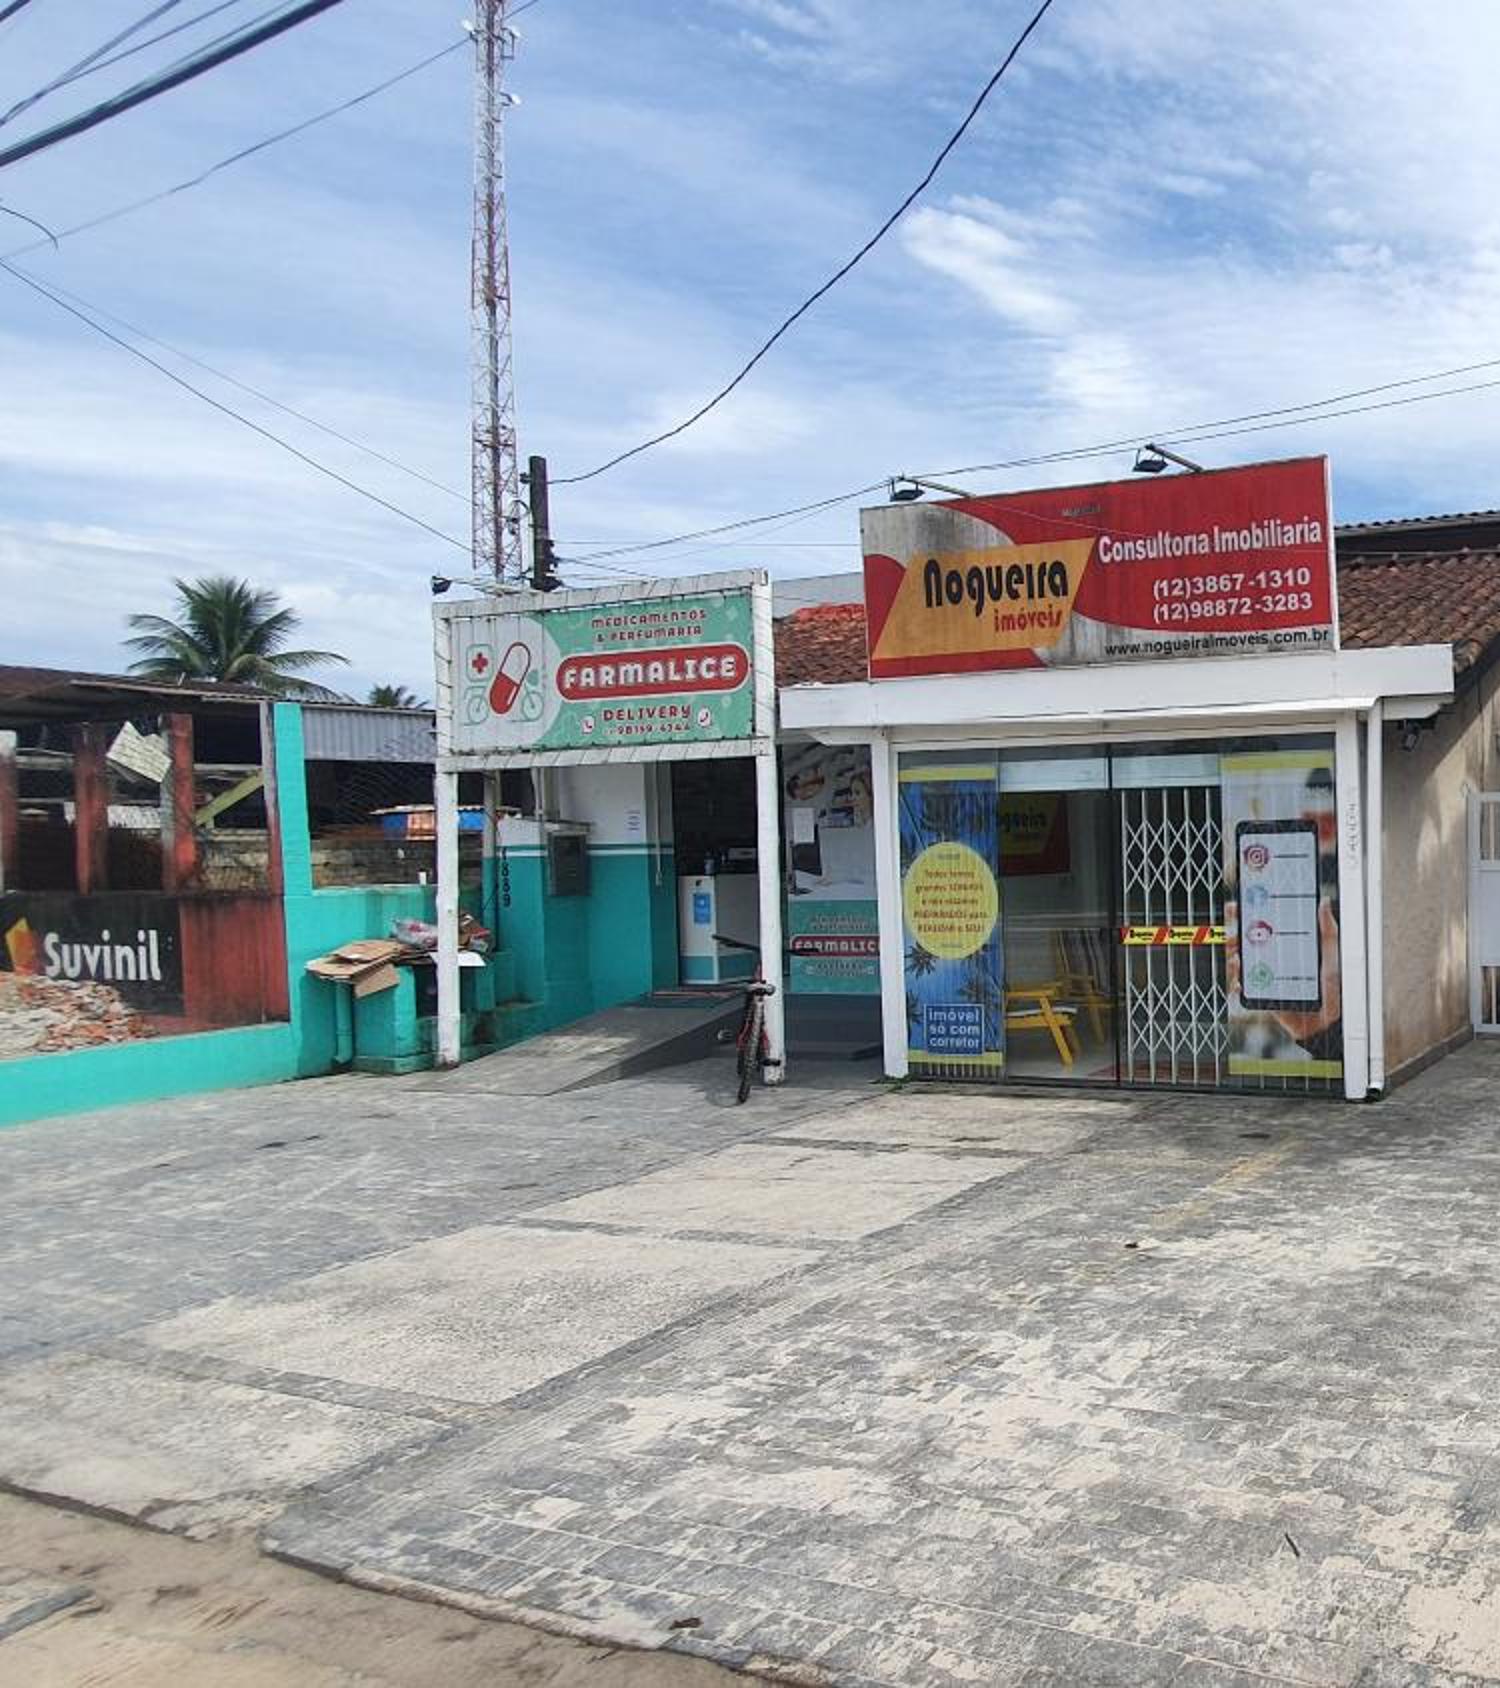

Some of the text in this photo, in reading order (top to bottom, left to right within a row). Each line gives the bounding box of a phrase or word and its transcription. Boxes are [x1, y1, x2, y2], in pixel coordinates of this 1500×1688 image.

[1099, 516, 1322, 563] Consultoria Imobiliaria
[924, 559, 1068, 617] Nogueira
[1153, 567, 1311, 600] (12)3867-1310
[994, 604, 1062, 632] imóveis
[1153, 591, 1313, 624] (12)98872-3283
[563, 654, 738, 690] FARMALICE
[603, 704, 691, 721] DELIVERY
[44, 929, 162, 981] Suvinil
[795, 940, 880, 952] FARMALIC
[950, 1025, 981, 1036] com
